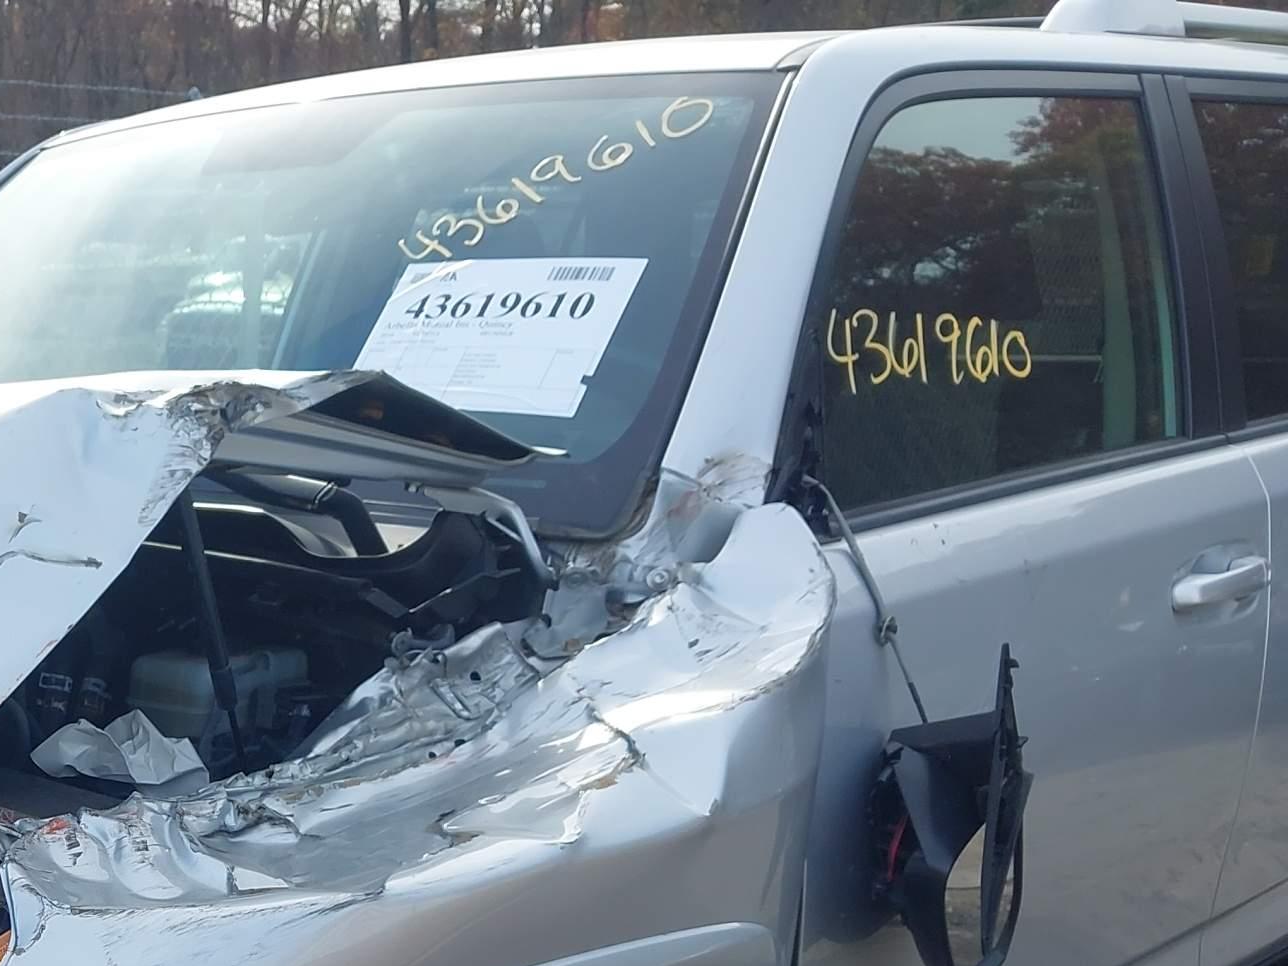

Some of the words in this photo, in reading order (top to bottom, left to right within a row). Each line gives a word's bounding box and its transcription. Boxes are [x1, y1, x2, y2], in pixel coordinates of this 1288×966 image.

[398, 96, 714, 260] 43619610
[404, 292, 596, 320] 43619610
[826, 308, 1033, 396] 43619610
